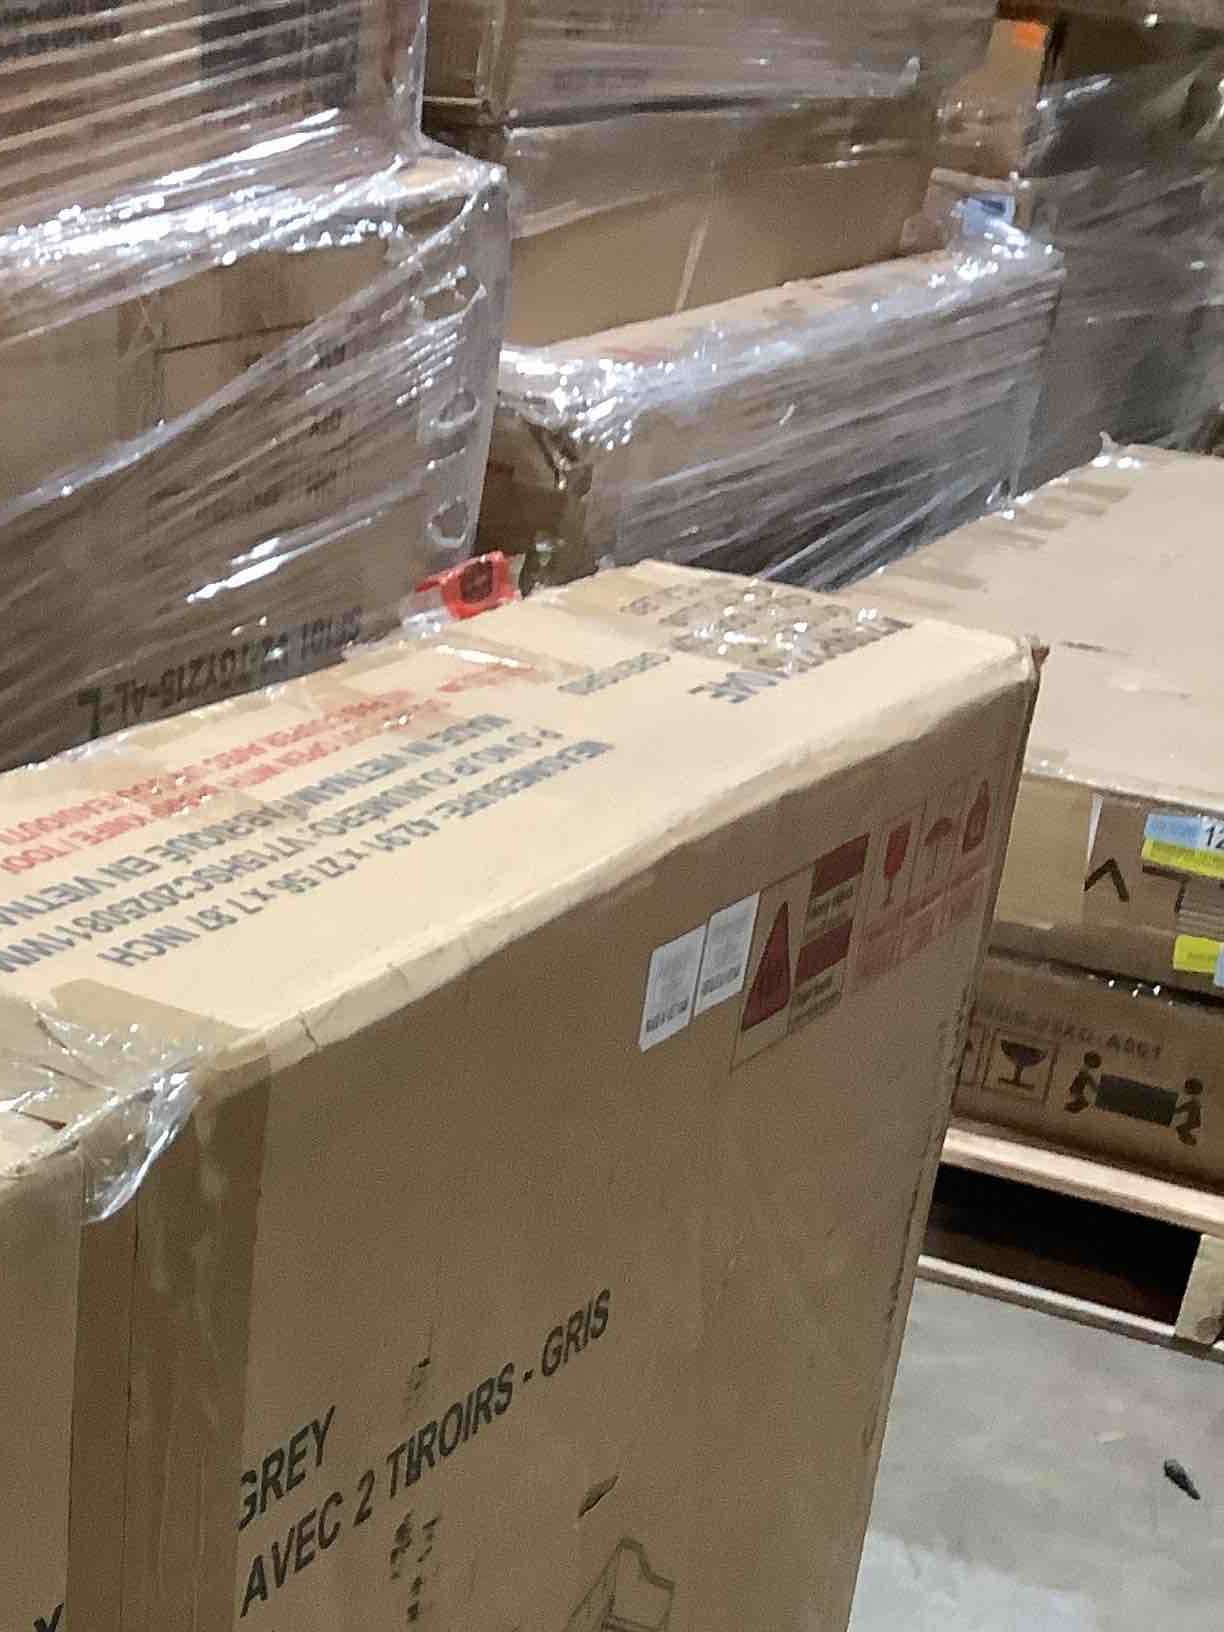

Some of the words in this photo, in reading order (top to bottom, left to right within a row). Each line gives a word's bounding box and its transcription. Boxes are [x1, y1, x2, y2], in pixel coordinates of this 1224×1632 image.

[97, 855, 161, 881] EN
[97, 926, 200, 967] INCH
[239, 1406, 335, 1530] GREY
[241, 1492, 343, 1616] AVEC
[353, 1469, 376, 1528] 2
[387, 1363, 514, 1497] TIROIRS
[541, 1289, 611, 1377] GRIS
